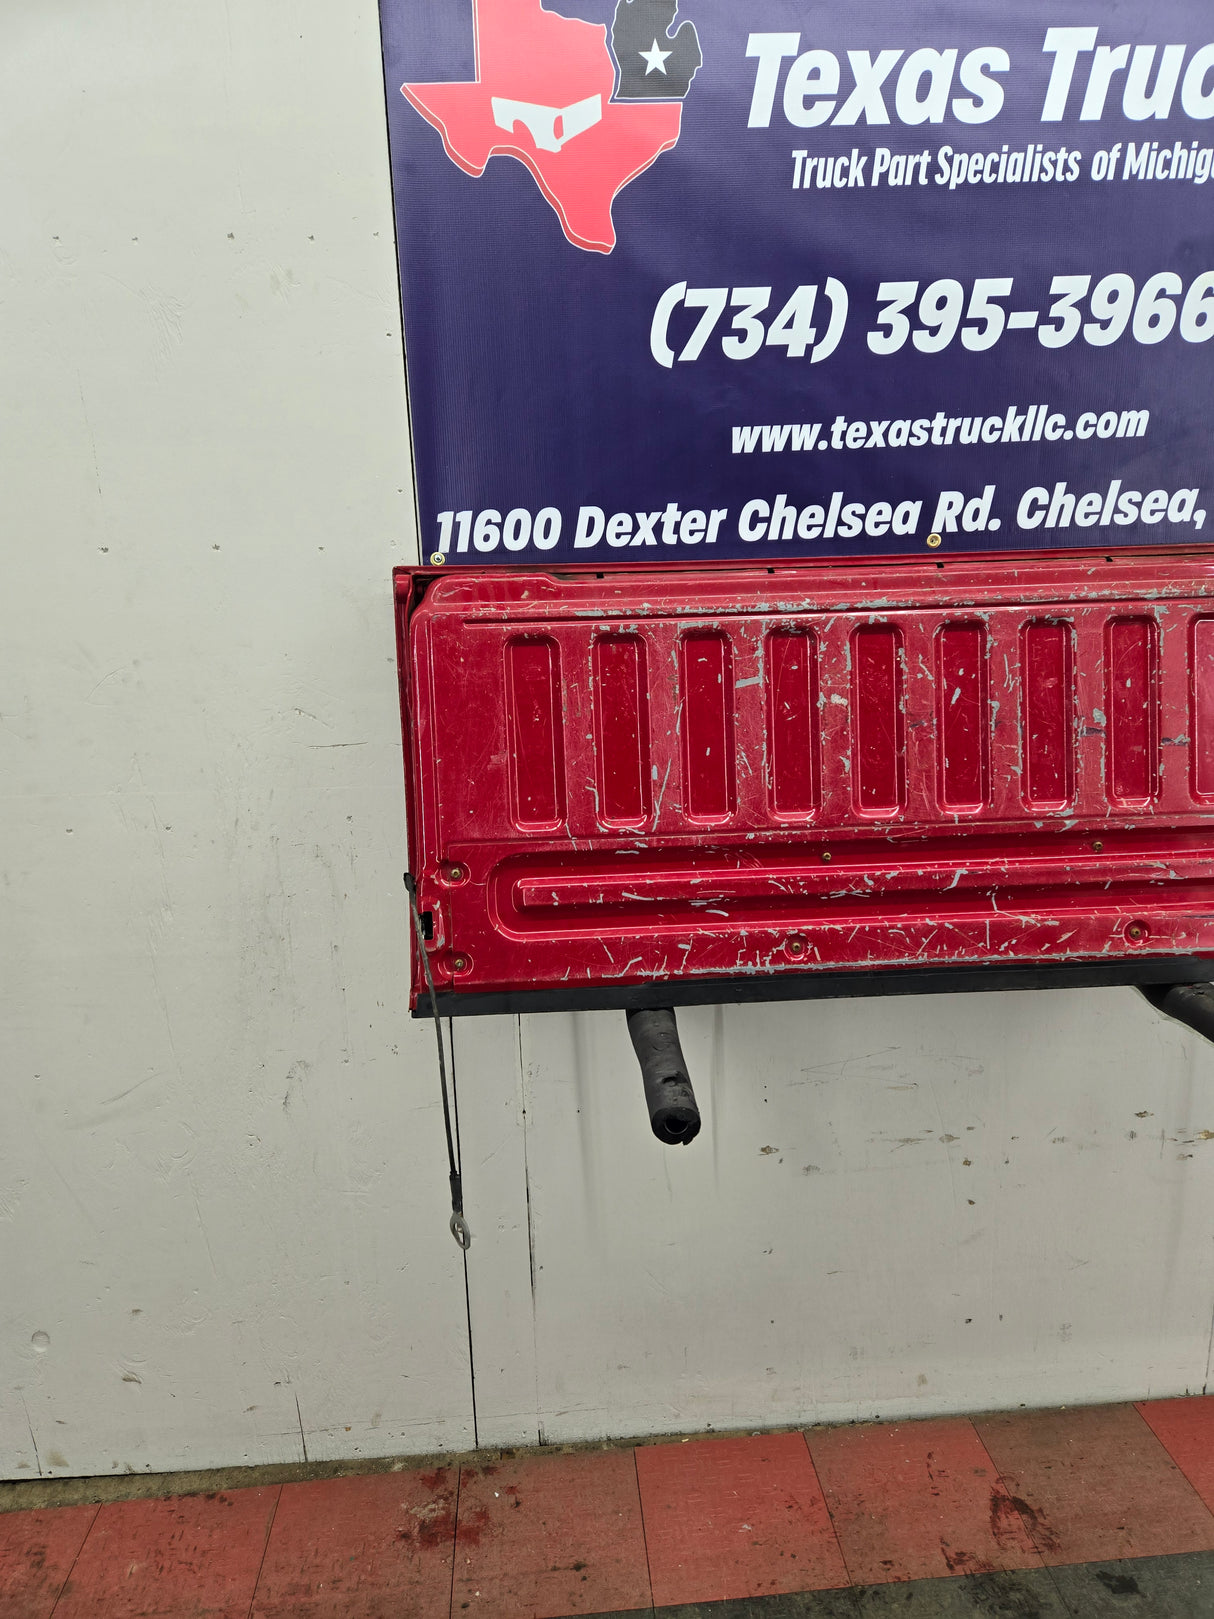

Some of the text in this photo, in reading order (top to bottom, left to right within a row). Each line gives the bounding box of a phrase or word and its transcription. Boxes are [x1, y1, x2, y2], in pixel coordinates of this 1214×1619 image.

[744, 31, 1011, 129] Texas
[791, 140, 1214, 190] Truck Part Specialists of Michig
[650, 270, 1214, 369] (734) 395-3966
[732, 404, 1150, 454] www.texastruckllc.com
[435, 479, 1207, 553] 11600 Dexter Chelsea Rd. Chelsea,
